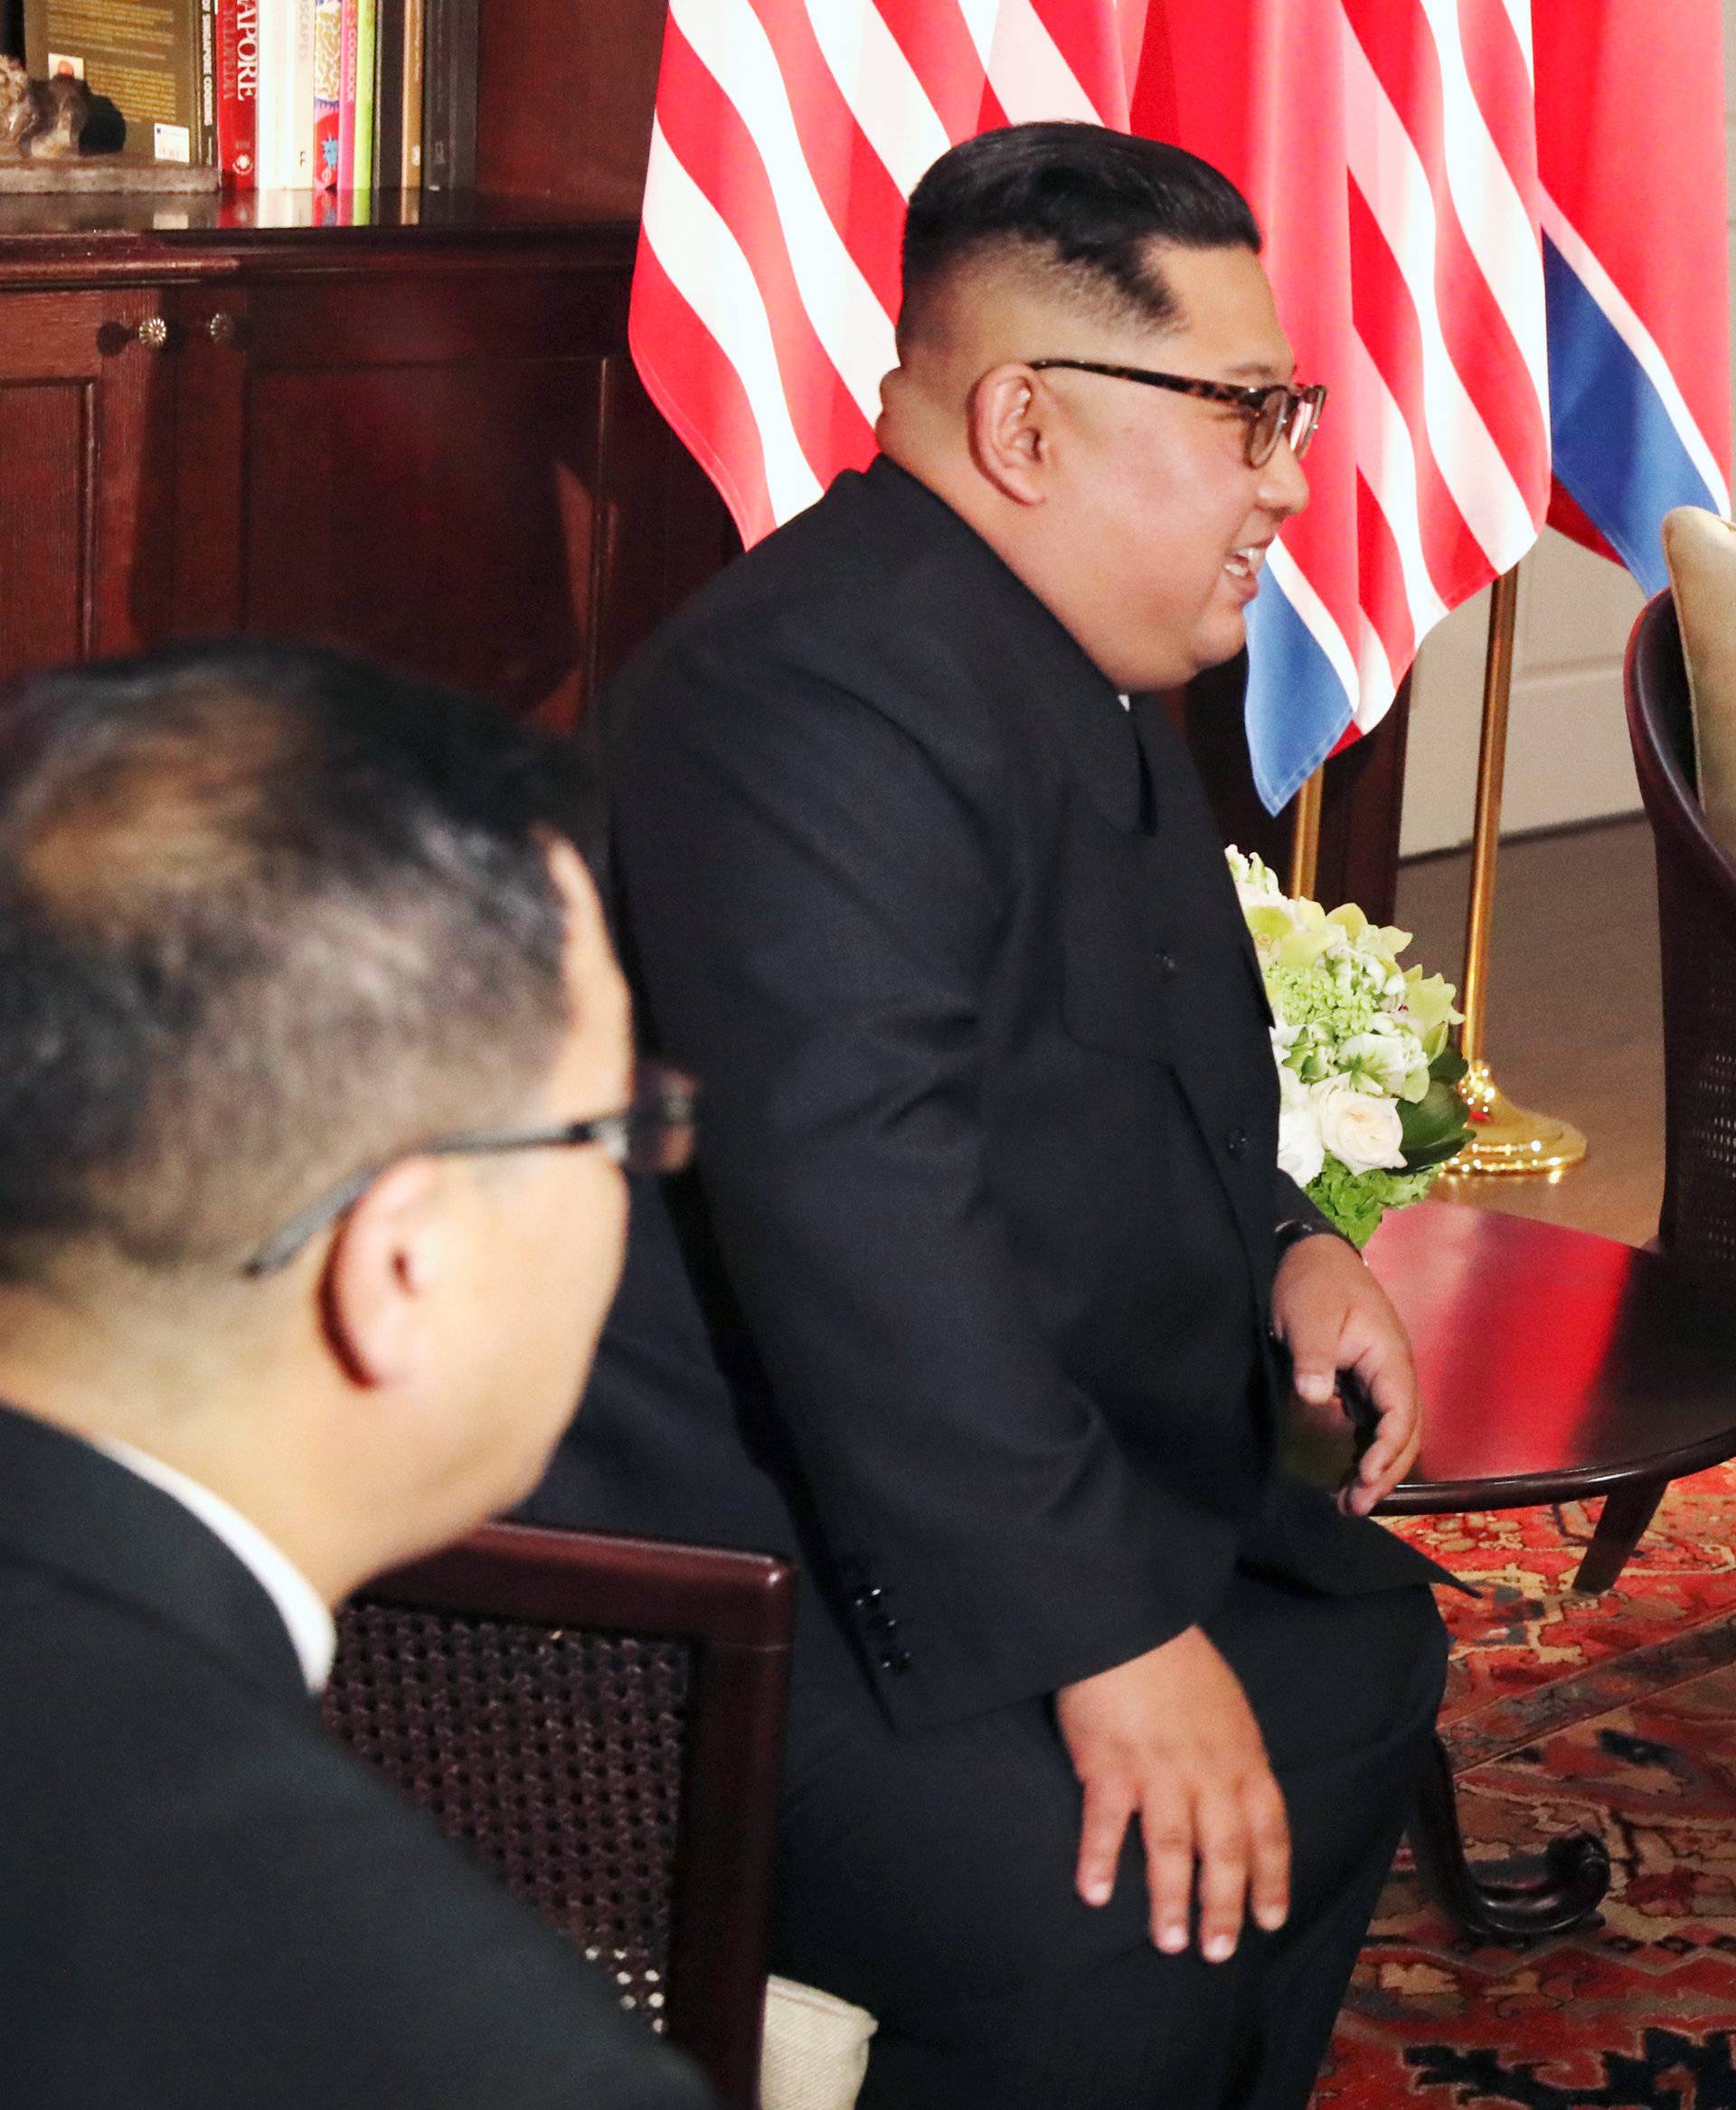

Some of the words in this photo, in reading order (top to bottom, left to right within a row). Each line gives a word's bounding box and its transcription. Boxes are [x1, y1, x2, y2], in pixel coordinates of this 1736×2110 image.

[237, 0, 259, 102] APORE
[299, 0, 310, 61] SCAPES
[346, 28, 356, 102] COOKBOOK
